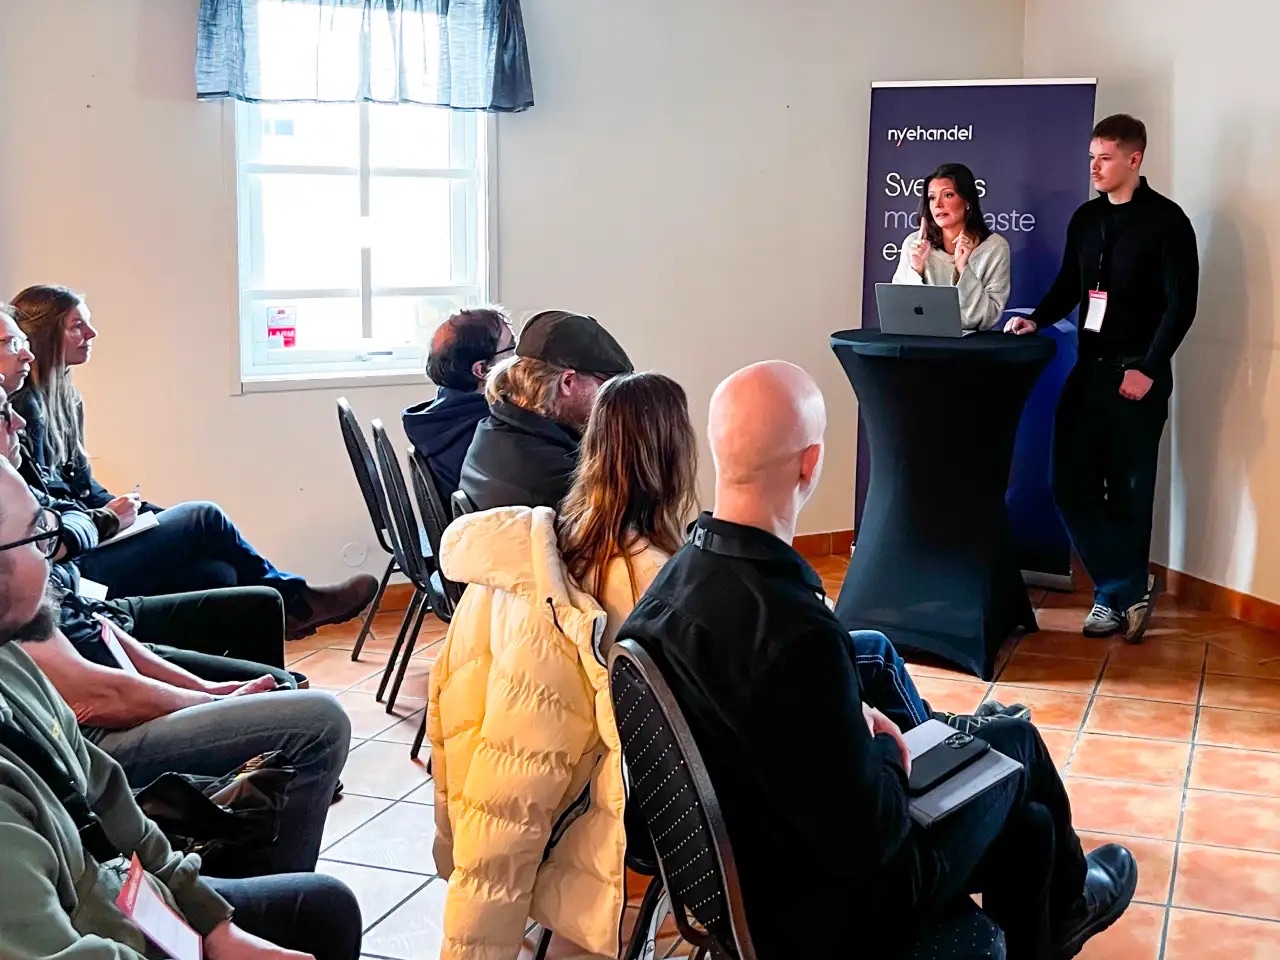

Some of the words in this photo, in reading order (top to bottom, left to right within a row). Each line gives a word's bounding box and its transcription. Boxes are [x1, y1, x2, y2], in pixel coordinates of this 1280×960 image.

[887, 125, 973, 147] nyehandel
[885, 172, 986, 198] Sves
[884, 209, 1036, 232] moaste
